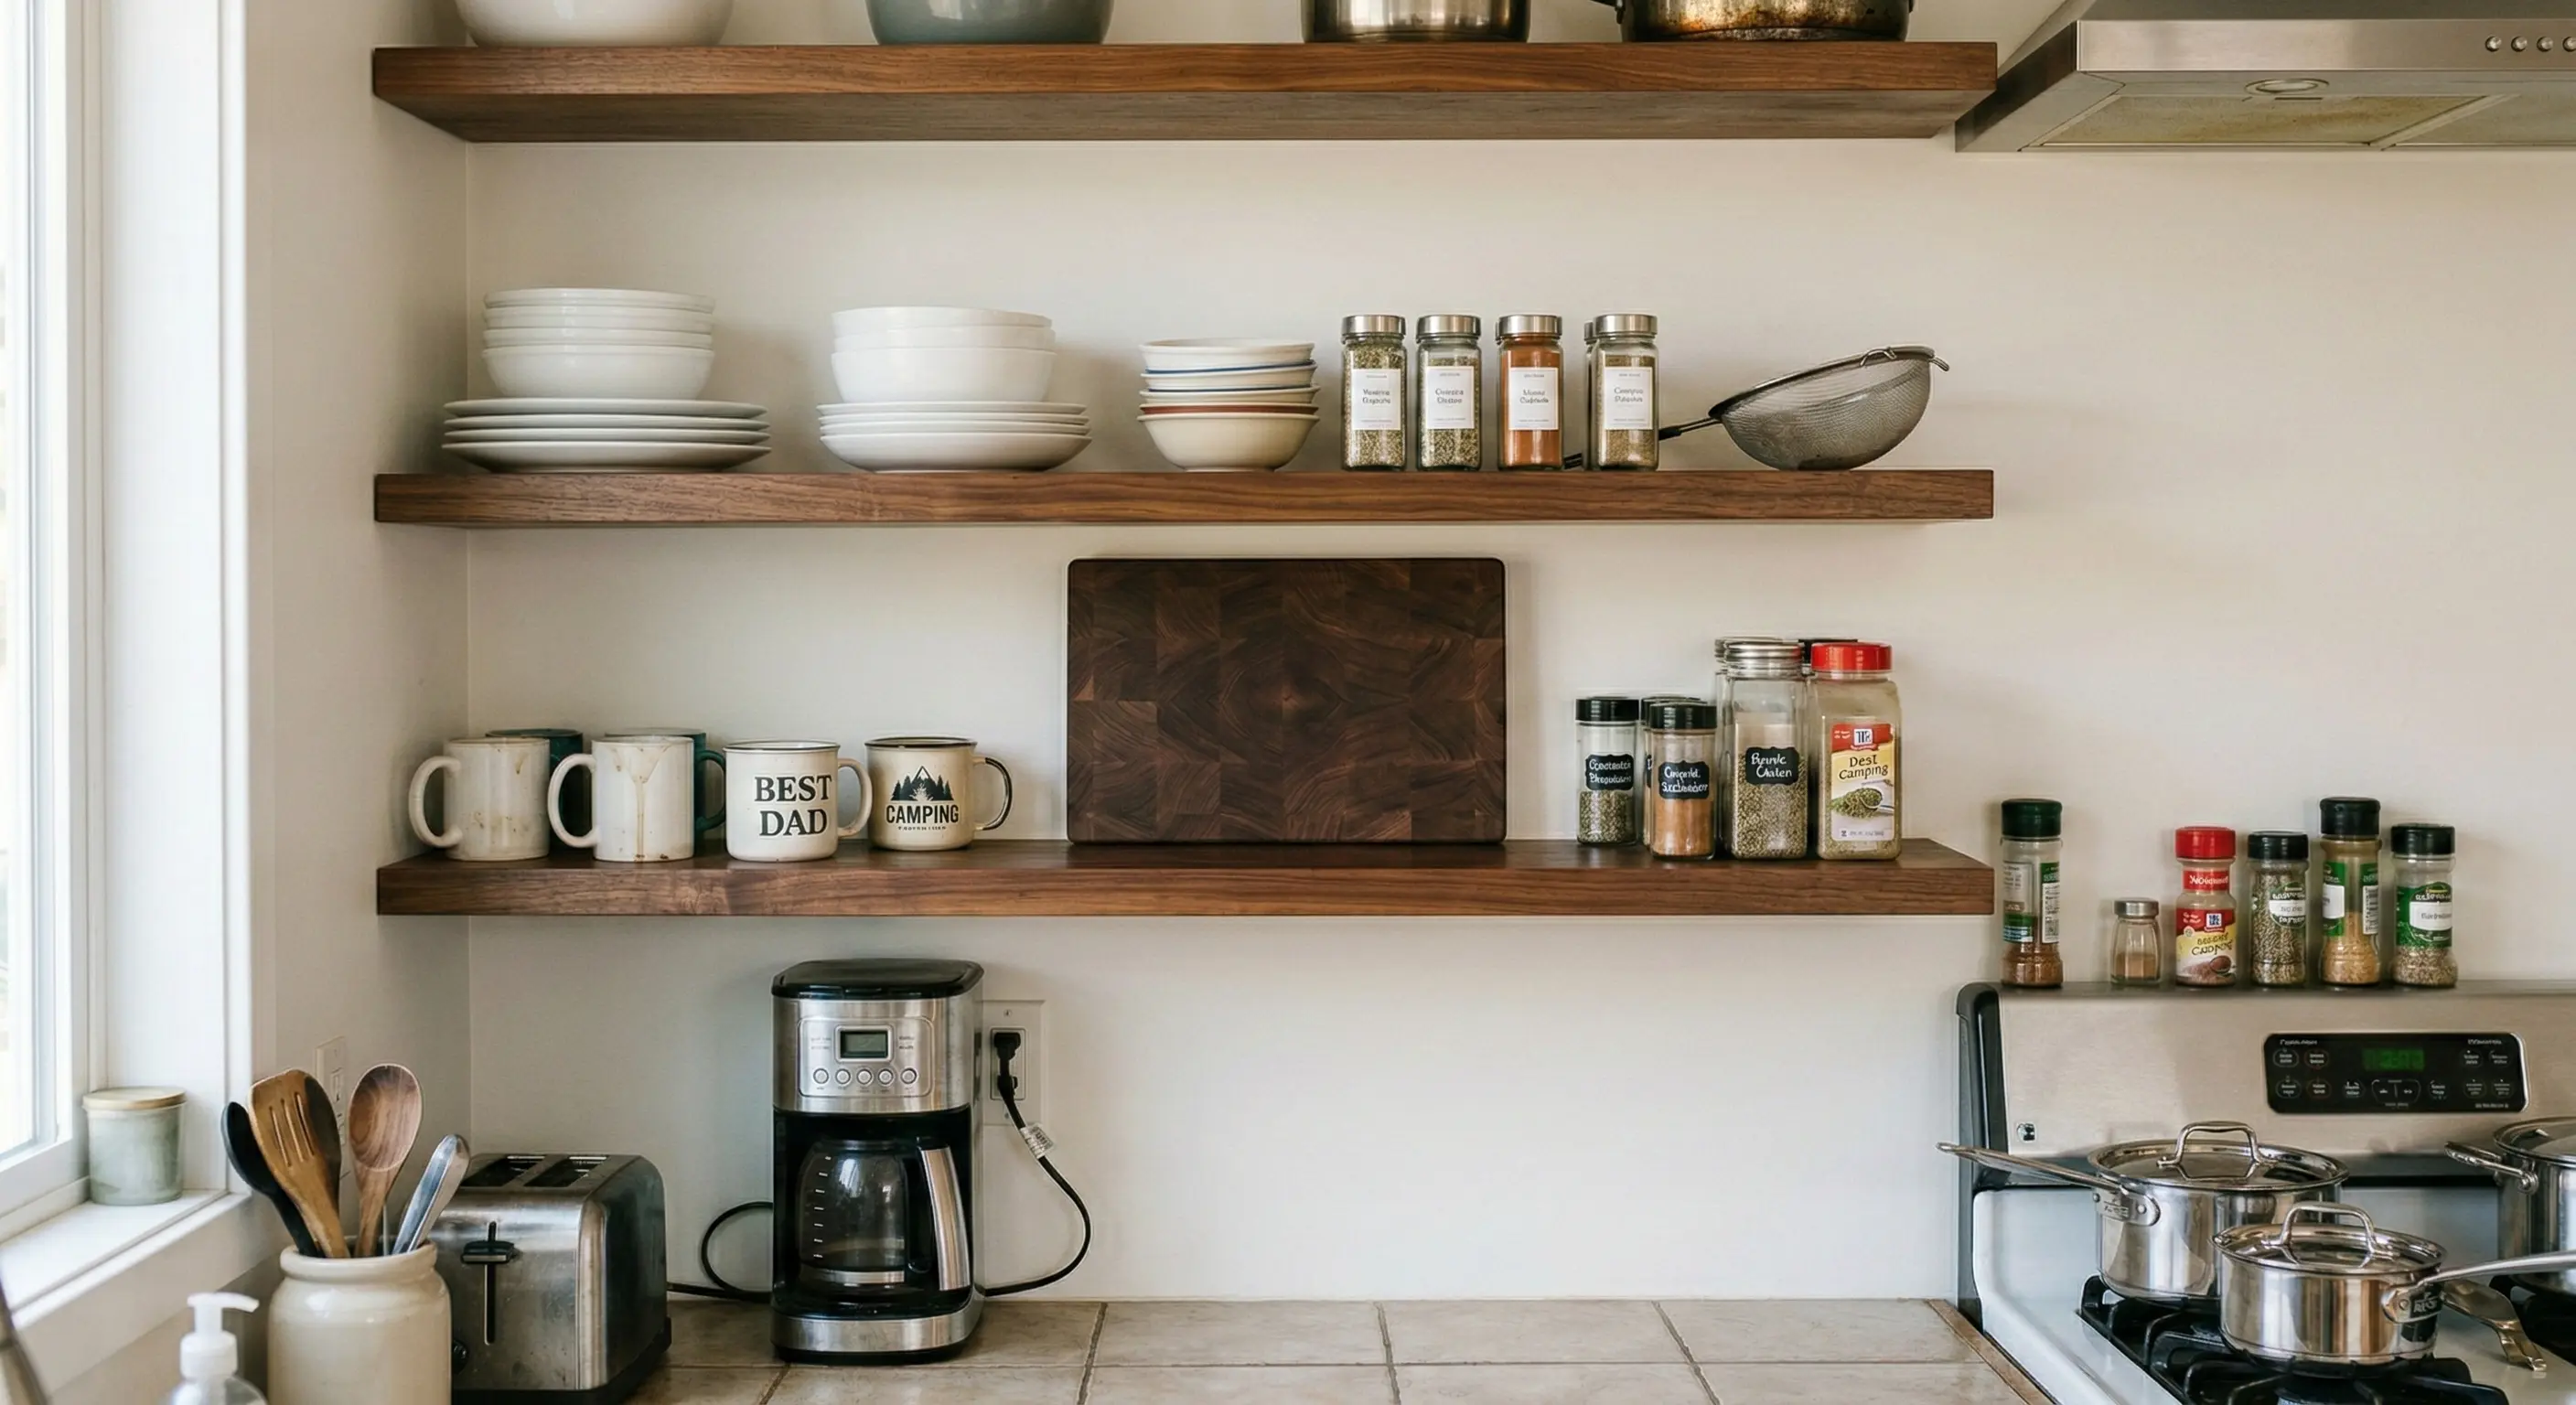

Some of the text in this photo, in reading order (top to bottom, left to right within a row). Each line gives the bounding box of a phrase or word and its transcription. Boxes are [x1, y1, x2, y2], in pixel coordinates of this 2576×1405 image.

[1839, 765, 1888, 780] Camping
[755, 774, 832, 802] BEST
[758, 809, 828, 837] DAD
[886, 804, 959, 824] CAMPING
